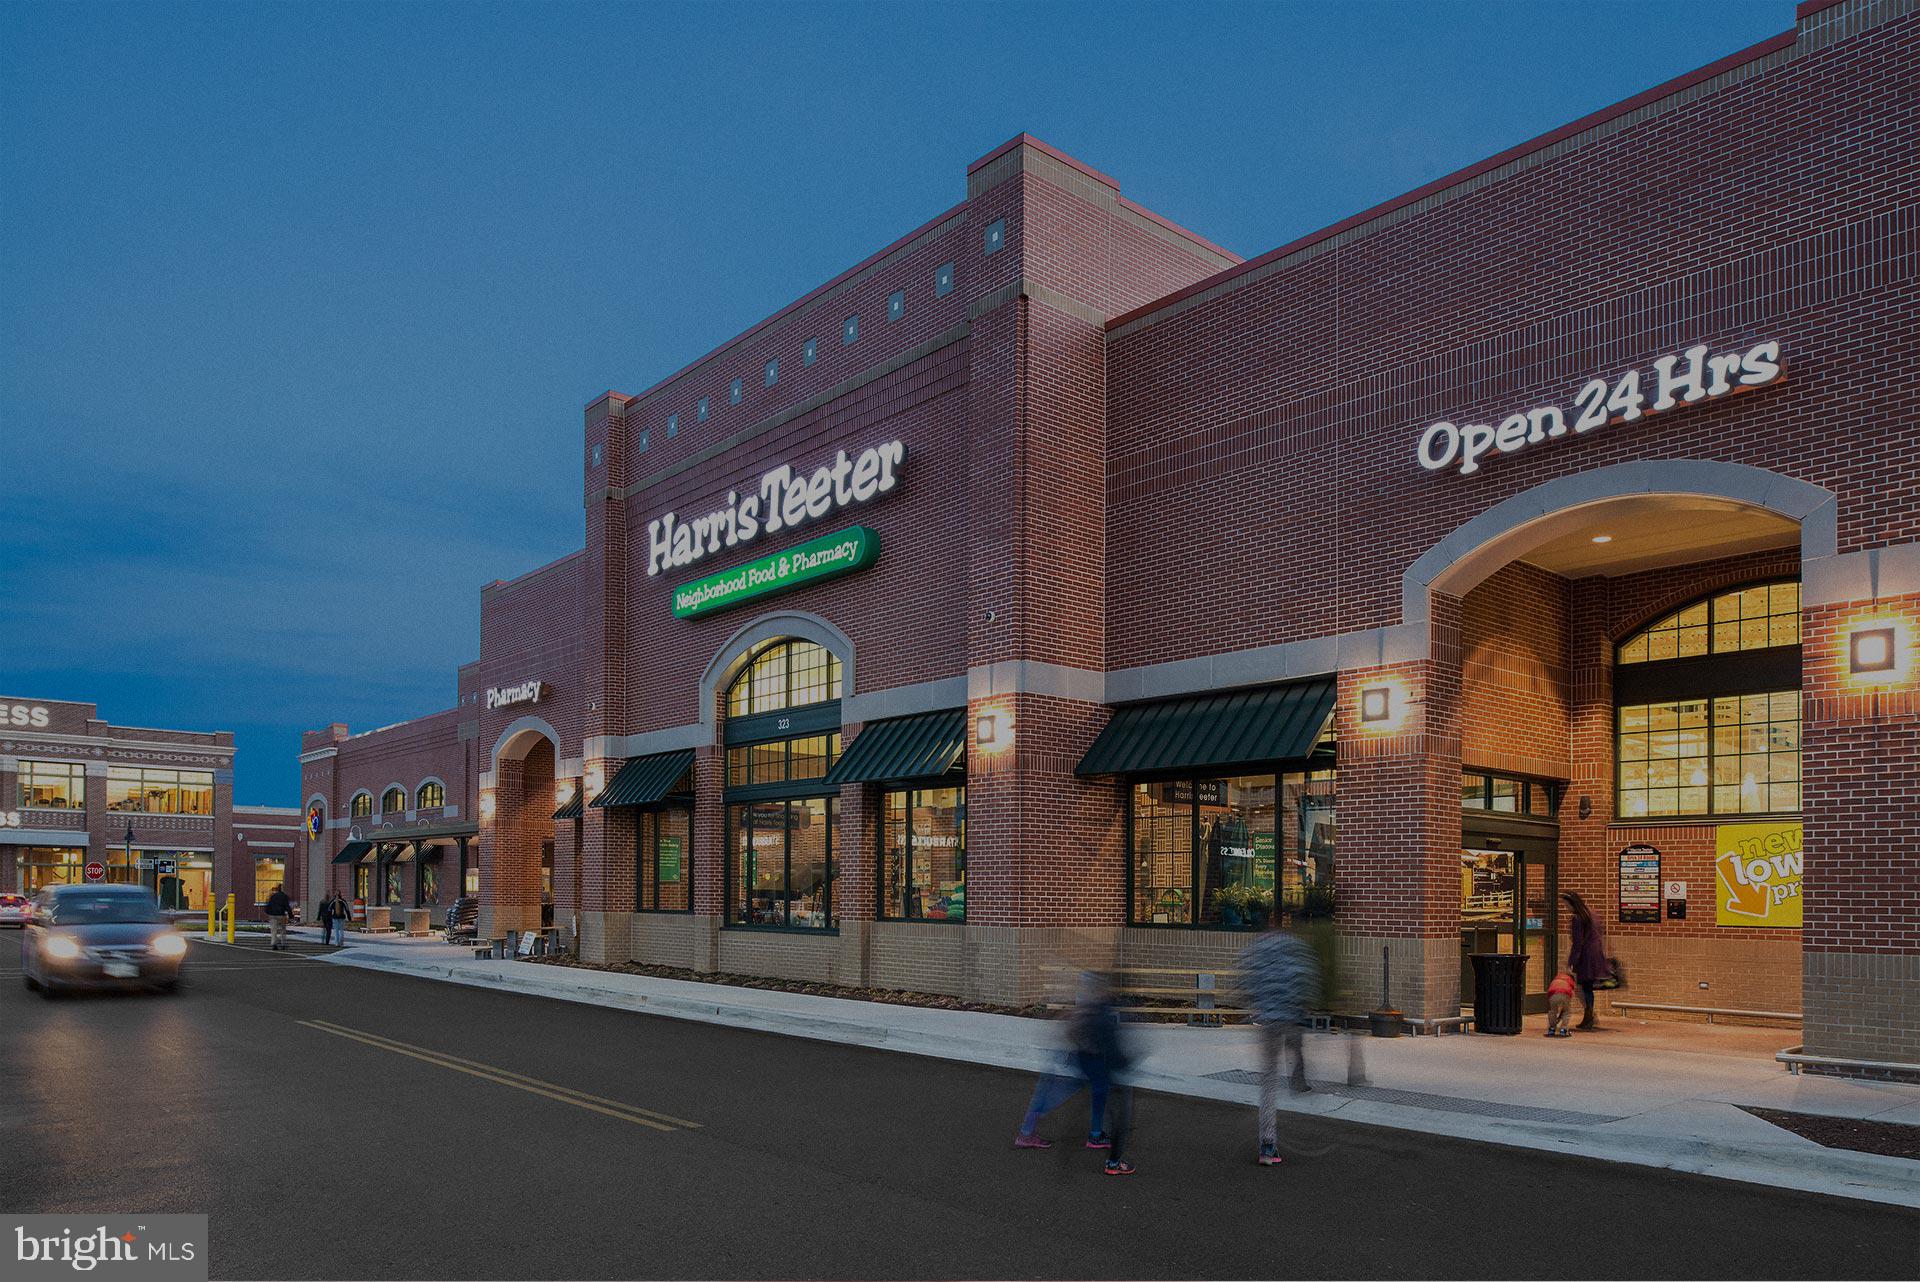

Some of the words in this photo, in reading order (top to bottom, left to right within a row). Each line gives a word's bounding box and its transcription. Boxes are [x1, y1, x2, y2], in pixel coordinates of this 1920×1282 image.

[1418, 405, 1567, 474] Open
[1574, 370, 1644, 434] 24
[1652, 340, 1780, 411] Hrs
[647, 491, 759, 577] Harris
[761, 440, 903, 533] Teeter
[676, 572, 747, 609] Neighborhood
[749, 562, 775, 587] Food
[778, 557, 790, 578] &
[792, 540, 859, 573] Pharmacy
[486, 681, 542, 710] Pharmacy
[777, 718, 790, 730] 323
[1199, 793, 1218, 802] eeter
[86, 867, 103, 875] STOP
[1729, 851, 1803, 886] low
[1771, 880, 1803, 905] pr
